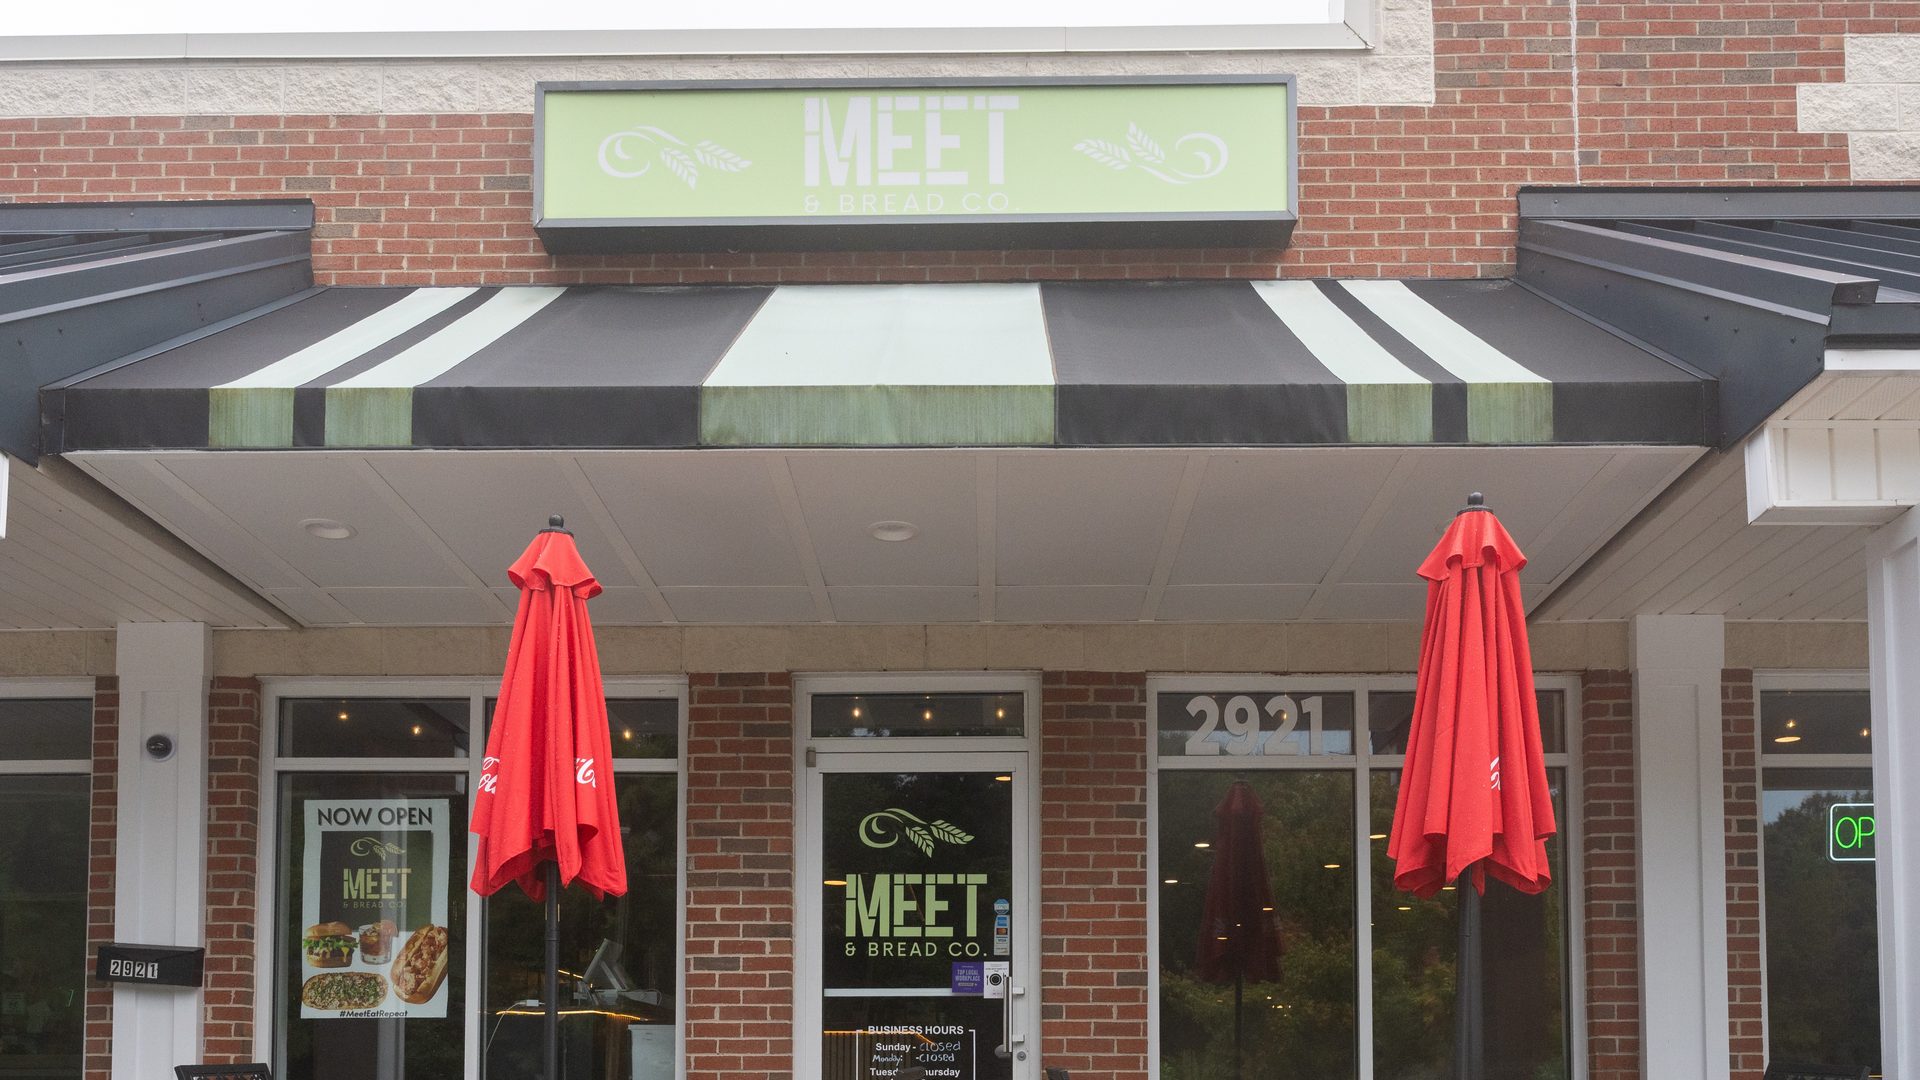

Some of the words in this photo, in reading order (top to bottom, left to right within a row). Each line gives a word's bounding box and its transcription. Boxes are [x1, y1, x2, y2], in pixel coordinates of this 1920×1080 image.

[804, 96, 1019, 187] MEET
[804, 193, 820, 213] &
[839, 193, 944, 213] BREAD
[961, 192, 1020, 212] CO.
[1185, 695, 1323, 756] 2921
[317, 807, 372, 826] NOW
[378, 807, 433, 826] OPEN
[1835, 816, 1876, 849] OP
[343, 868, 412, 900] MEET
[845, 873, 988, 937] MEET
[845, 942, 856, 957] &
[868, 942, 938, 957] BREAD
[948, 942, 988, 957] CO.
[110, 960, 158, 978] 2921
[339, 1009, 408, 1019] #MeetEatRepeat
[868, 1025, 923, 1035] BUSINESS
[925, 1025, 964, 1035] HOURS
[875, 1043, 911, 1053] Sunday
